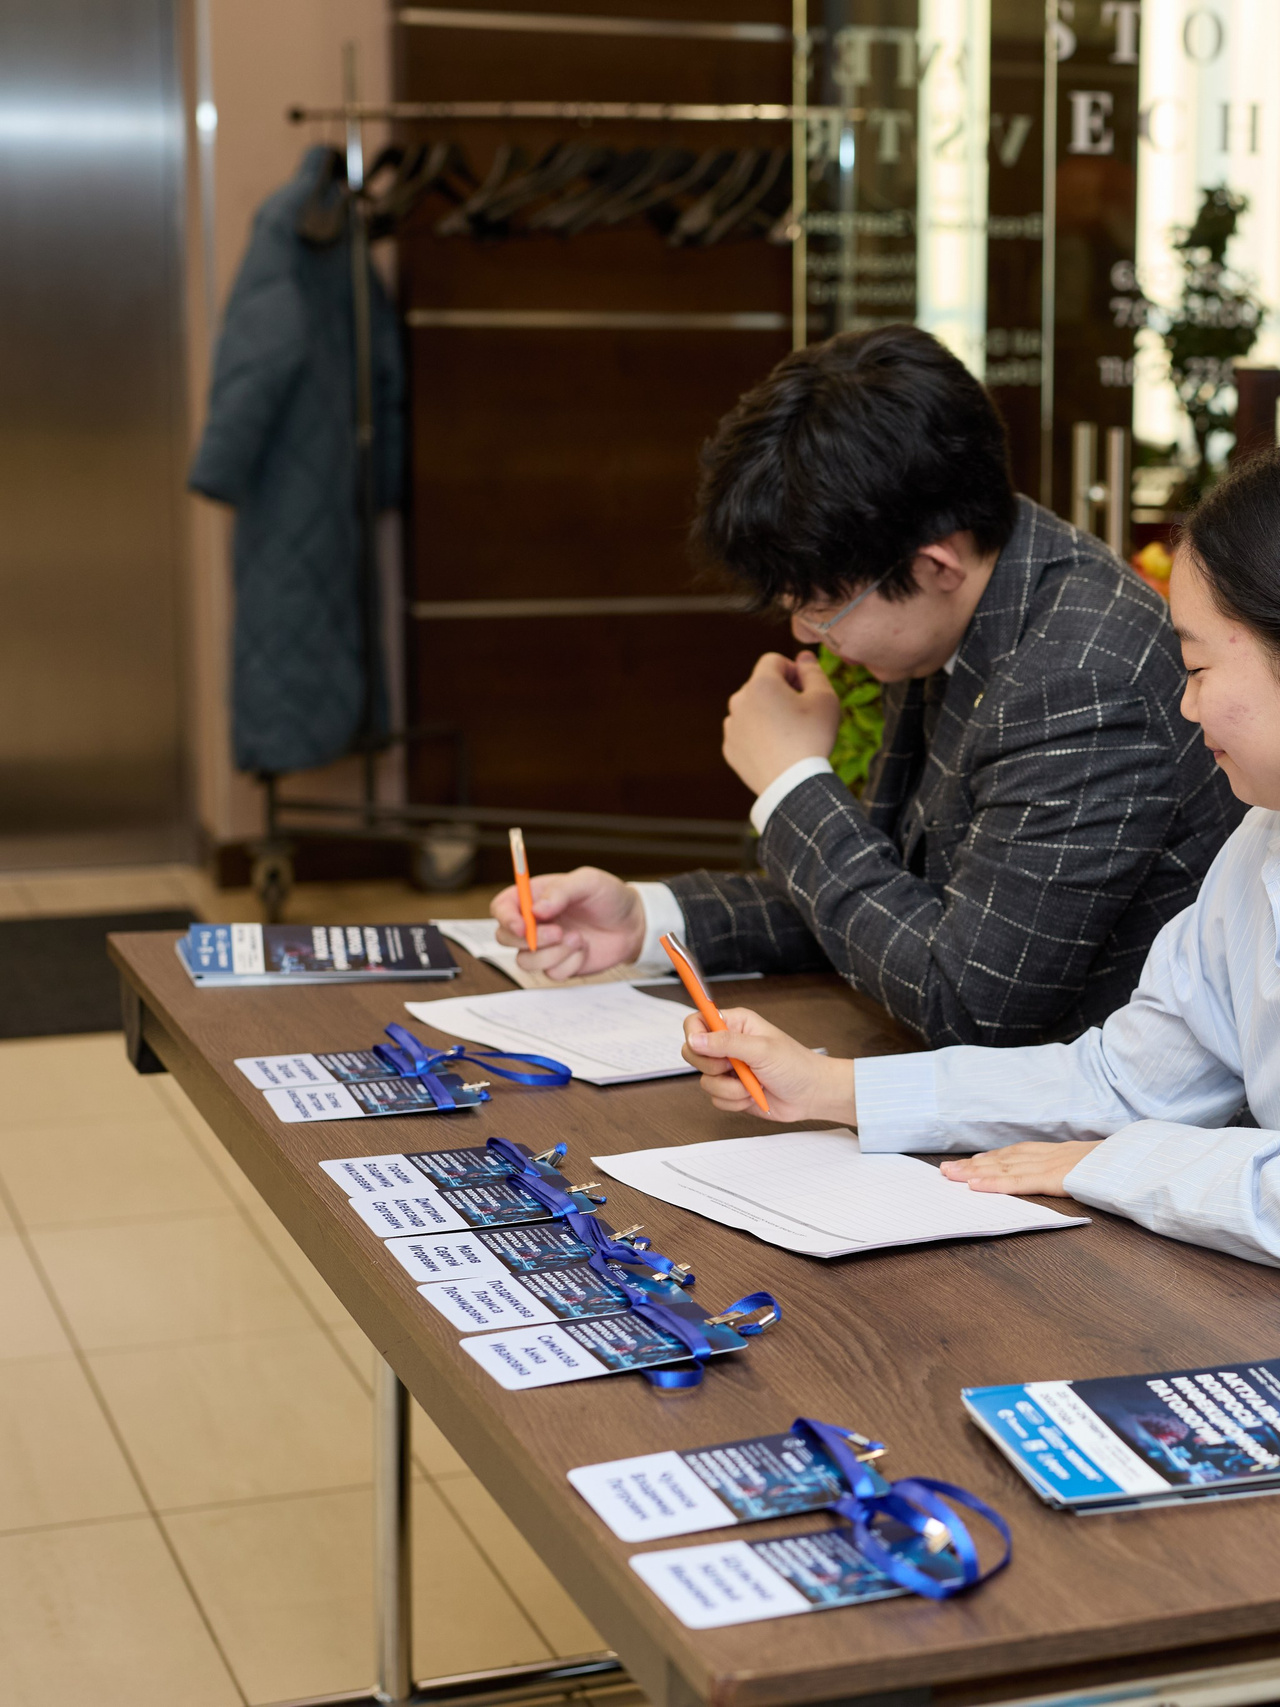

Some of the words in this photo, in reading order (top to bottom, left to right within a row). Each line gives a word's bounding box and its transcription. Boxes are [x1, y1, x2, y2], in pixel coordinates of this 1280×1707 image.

[340, 1162, 377, 1193] Николаевич
[363, 1163, 395, 1188] Владимир
[372, 1201, 405, 1230] Сергеевич
[392, 1199, 426, 1228] Александр
[412, 1198, 447, 1224] Дмитриев
[408, 1244, 441, 1273] Игоревич
[433, 1245, 463, 1267] Сергей
[456, 1244, 481, 1264] Малов
[440, 1286, 489, 1325] Леонидовна
[471, 1290, 504, 1314] Лариса
[487, 1280, 535, 1319] Позднякова
[489, 1342, 531, 1377] Ивановна
[520, 1347, 547, 1365] Анна
[537, 1335, 579, 1369] Симакова
[1146, 1379, 1226, 1445] ПАТОЛОГИИ
[1194, 1373, 1263, 1428] ВОПРОСЫ
[1170, 1376, 1280, 1467] ИНФЕКЦИОННОЙ
